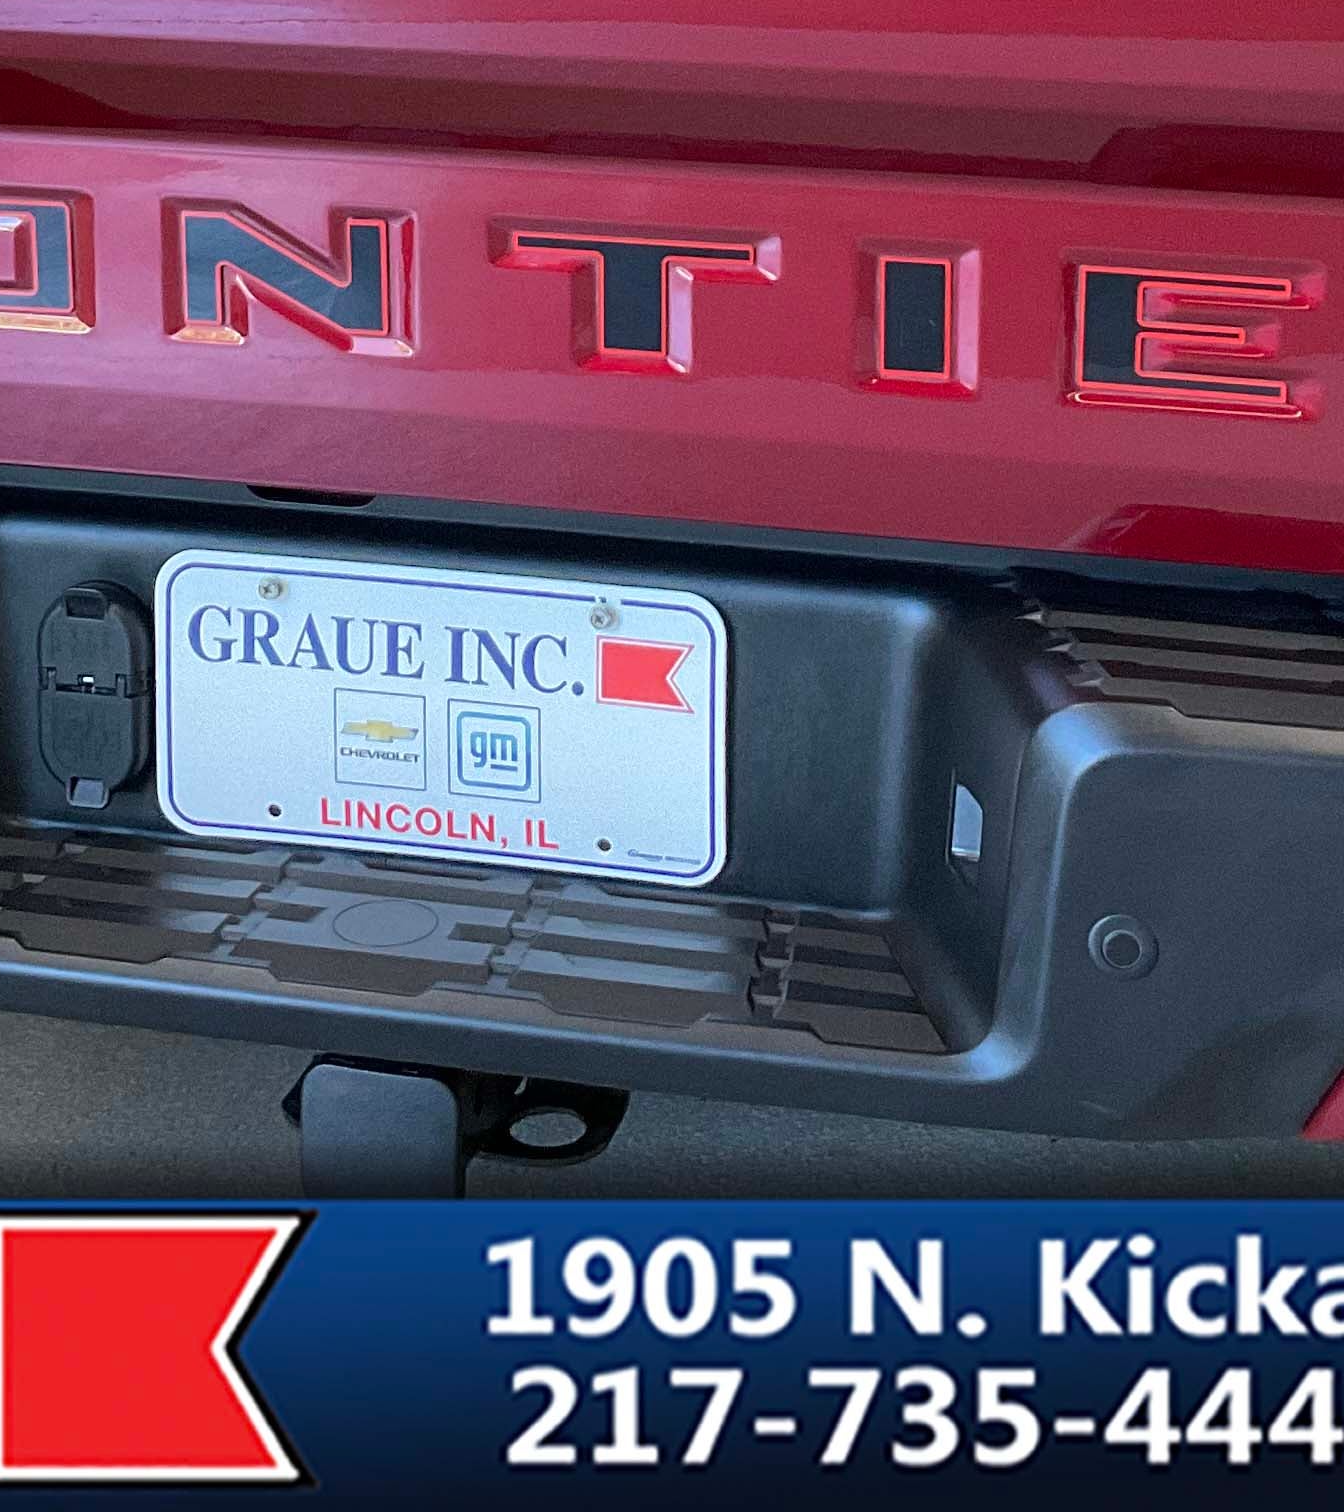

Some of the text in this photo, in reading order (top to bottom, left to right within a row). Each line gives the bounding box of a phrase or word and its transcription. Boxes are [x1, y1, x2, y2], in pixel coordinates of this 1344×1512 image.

[187, 604, 585, 697] GRAUE INC.
[340, 746, 420, 764] CHEVROLET
[470, 731, 518, 768] gm
[321, 797, 559, 850] LINCOLN, IL
